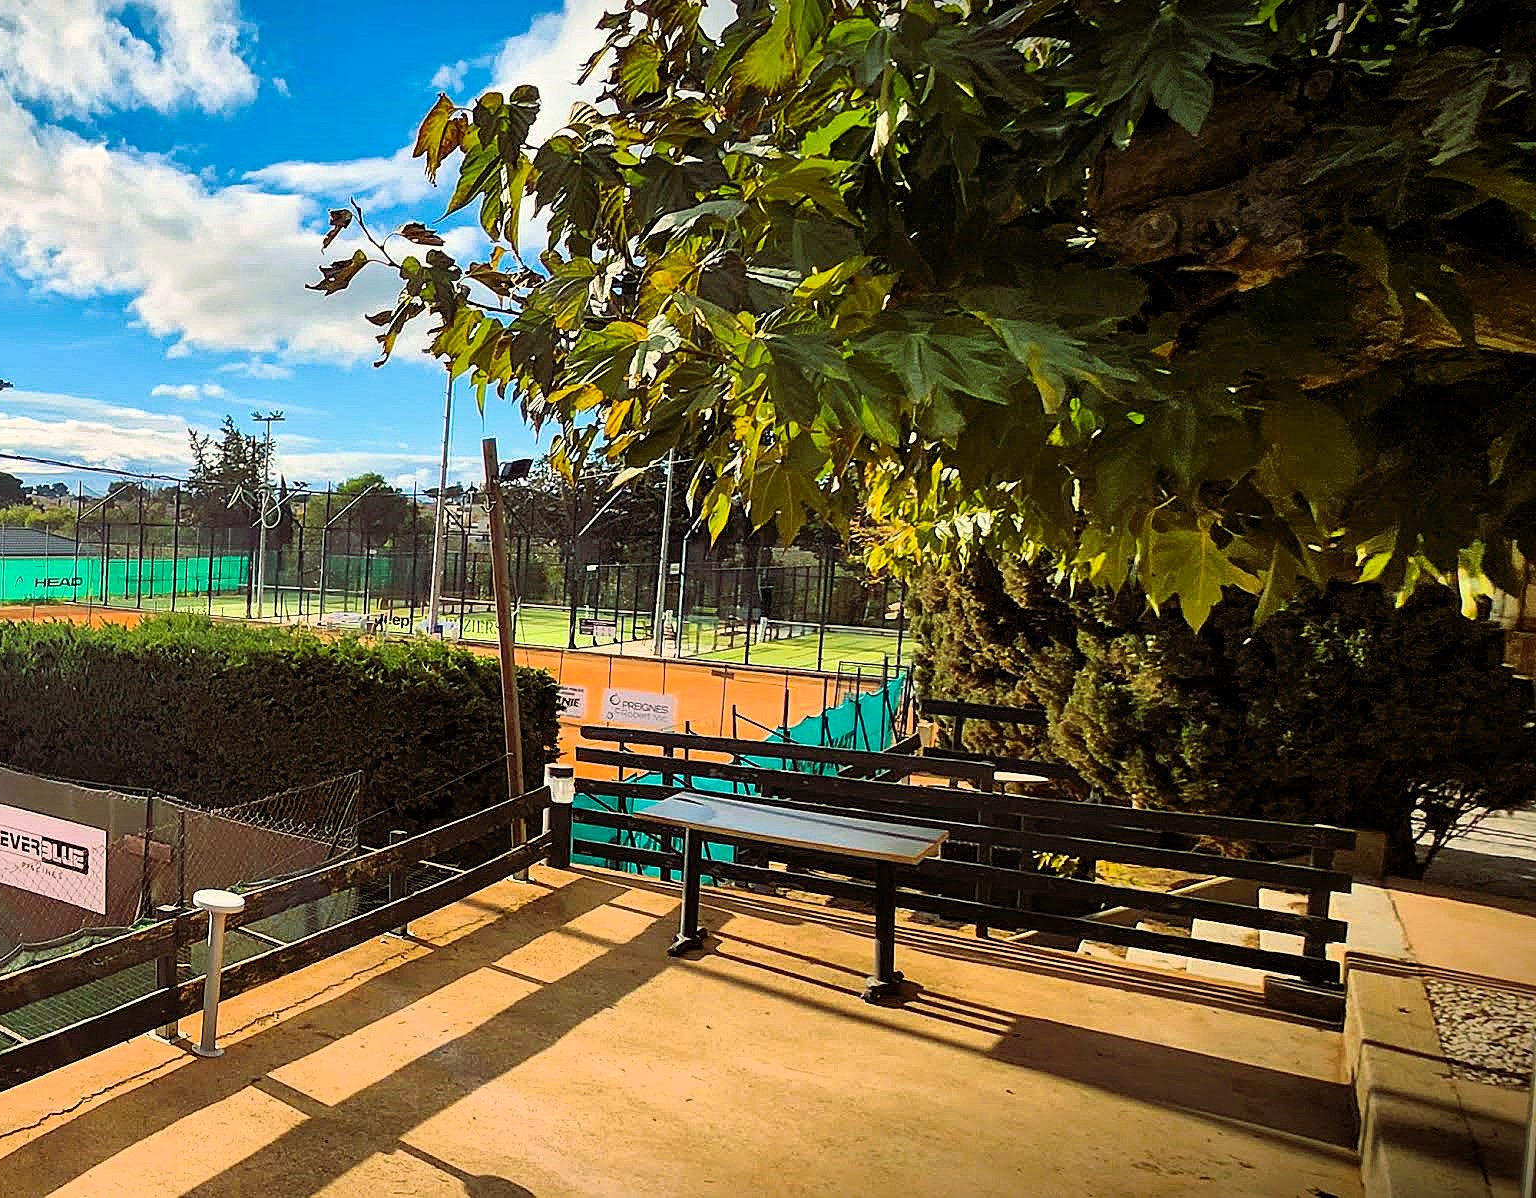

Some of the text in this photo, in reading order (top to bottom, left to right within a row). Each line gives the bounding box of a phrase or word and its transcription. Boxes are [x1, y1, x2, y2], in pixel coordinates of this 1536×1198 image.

[35, 577, 84, 589] HEAD
[622, 700, 670, 714] PREIGNES
[0, 830, 86, 870] EVERBLUE
